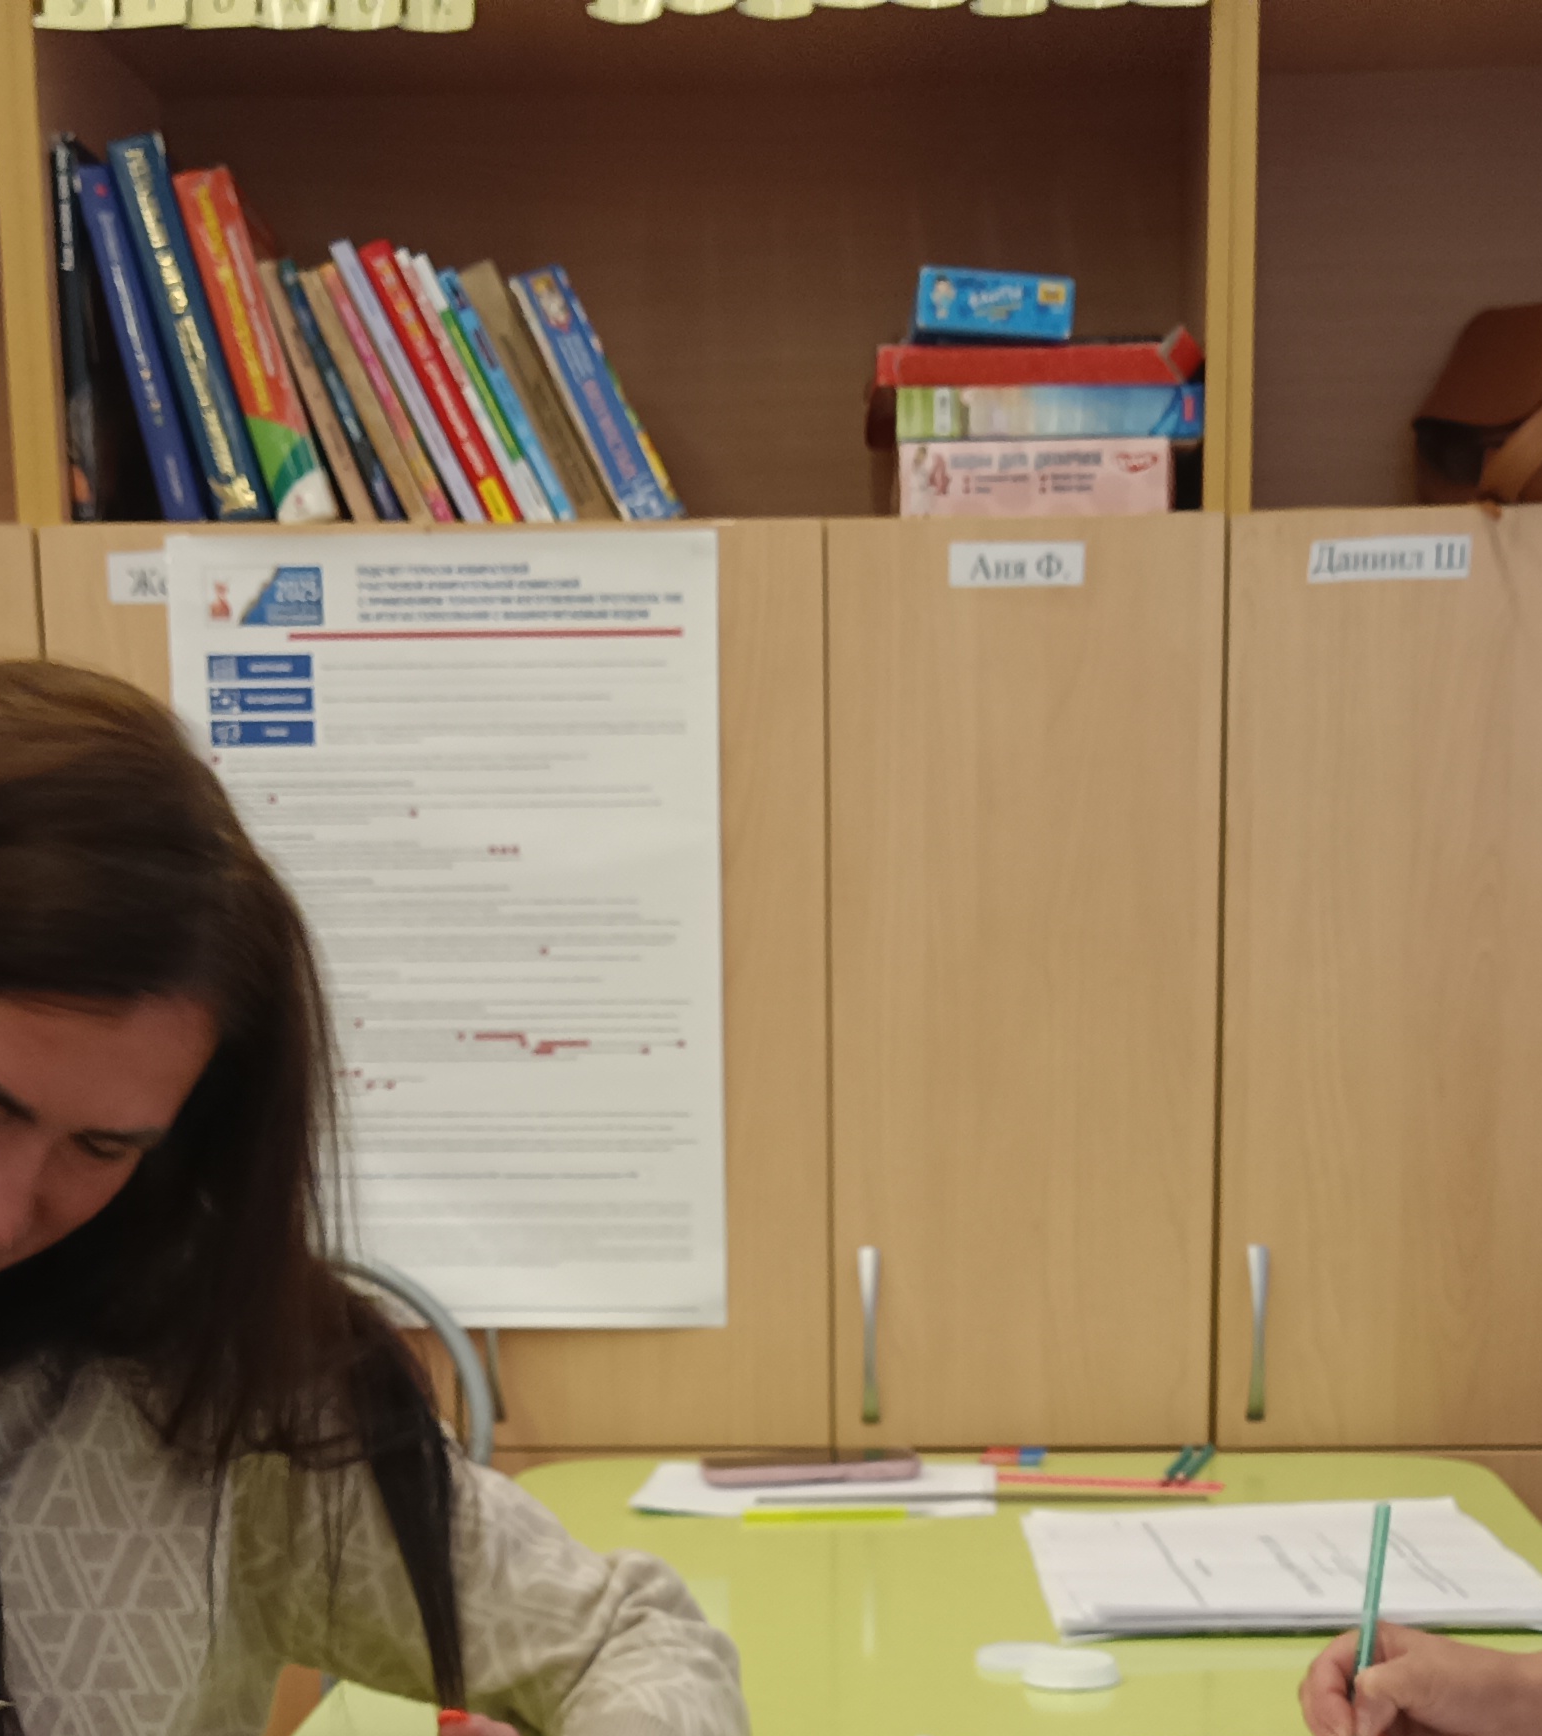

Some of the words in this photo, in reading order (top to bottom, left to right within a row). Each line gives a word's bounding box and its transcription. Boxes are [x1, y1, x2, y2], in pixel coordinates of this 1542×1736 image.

[970, 553, 1026, 582] Аня
[1312, 544, 1423, 578] Даниил
[1435, 541, 1468, 574] Ш
